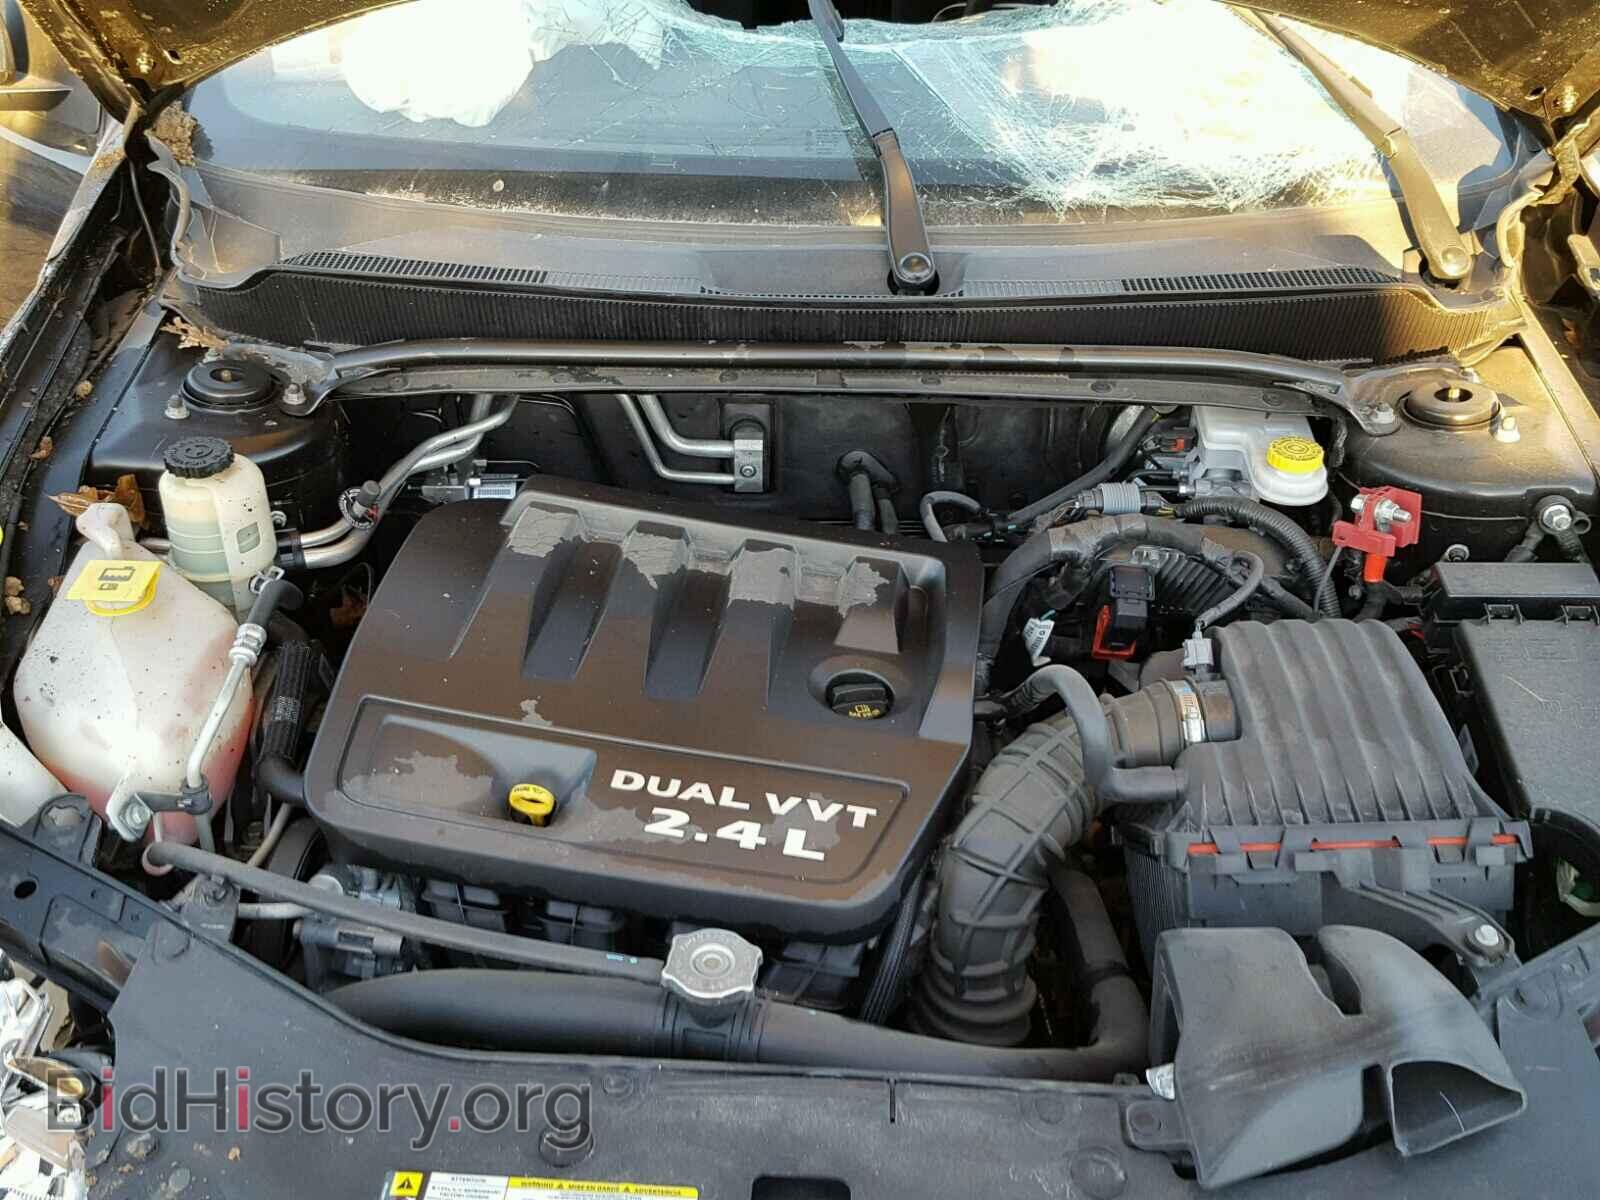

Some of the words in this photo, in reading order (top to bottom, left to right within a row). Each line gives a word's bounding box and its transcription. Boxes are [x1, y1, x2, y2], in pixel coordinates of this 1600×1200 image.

[610, 769, 750, 811] DUAL
[765, 792, 877, 828] VVT
[644, 807, 825, 861] 2.4L
